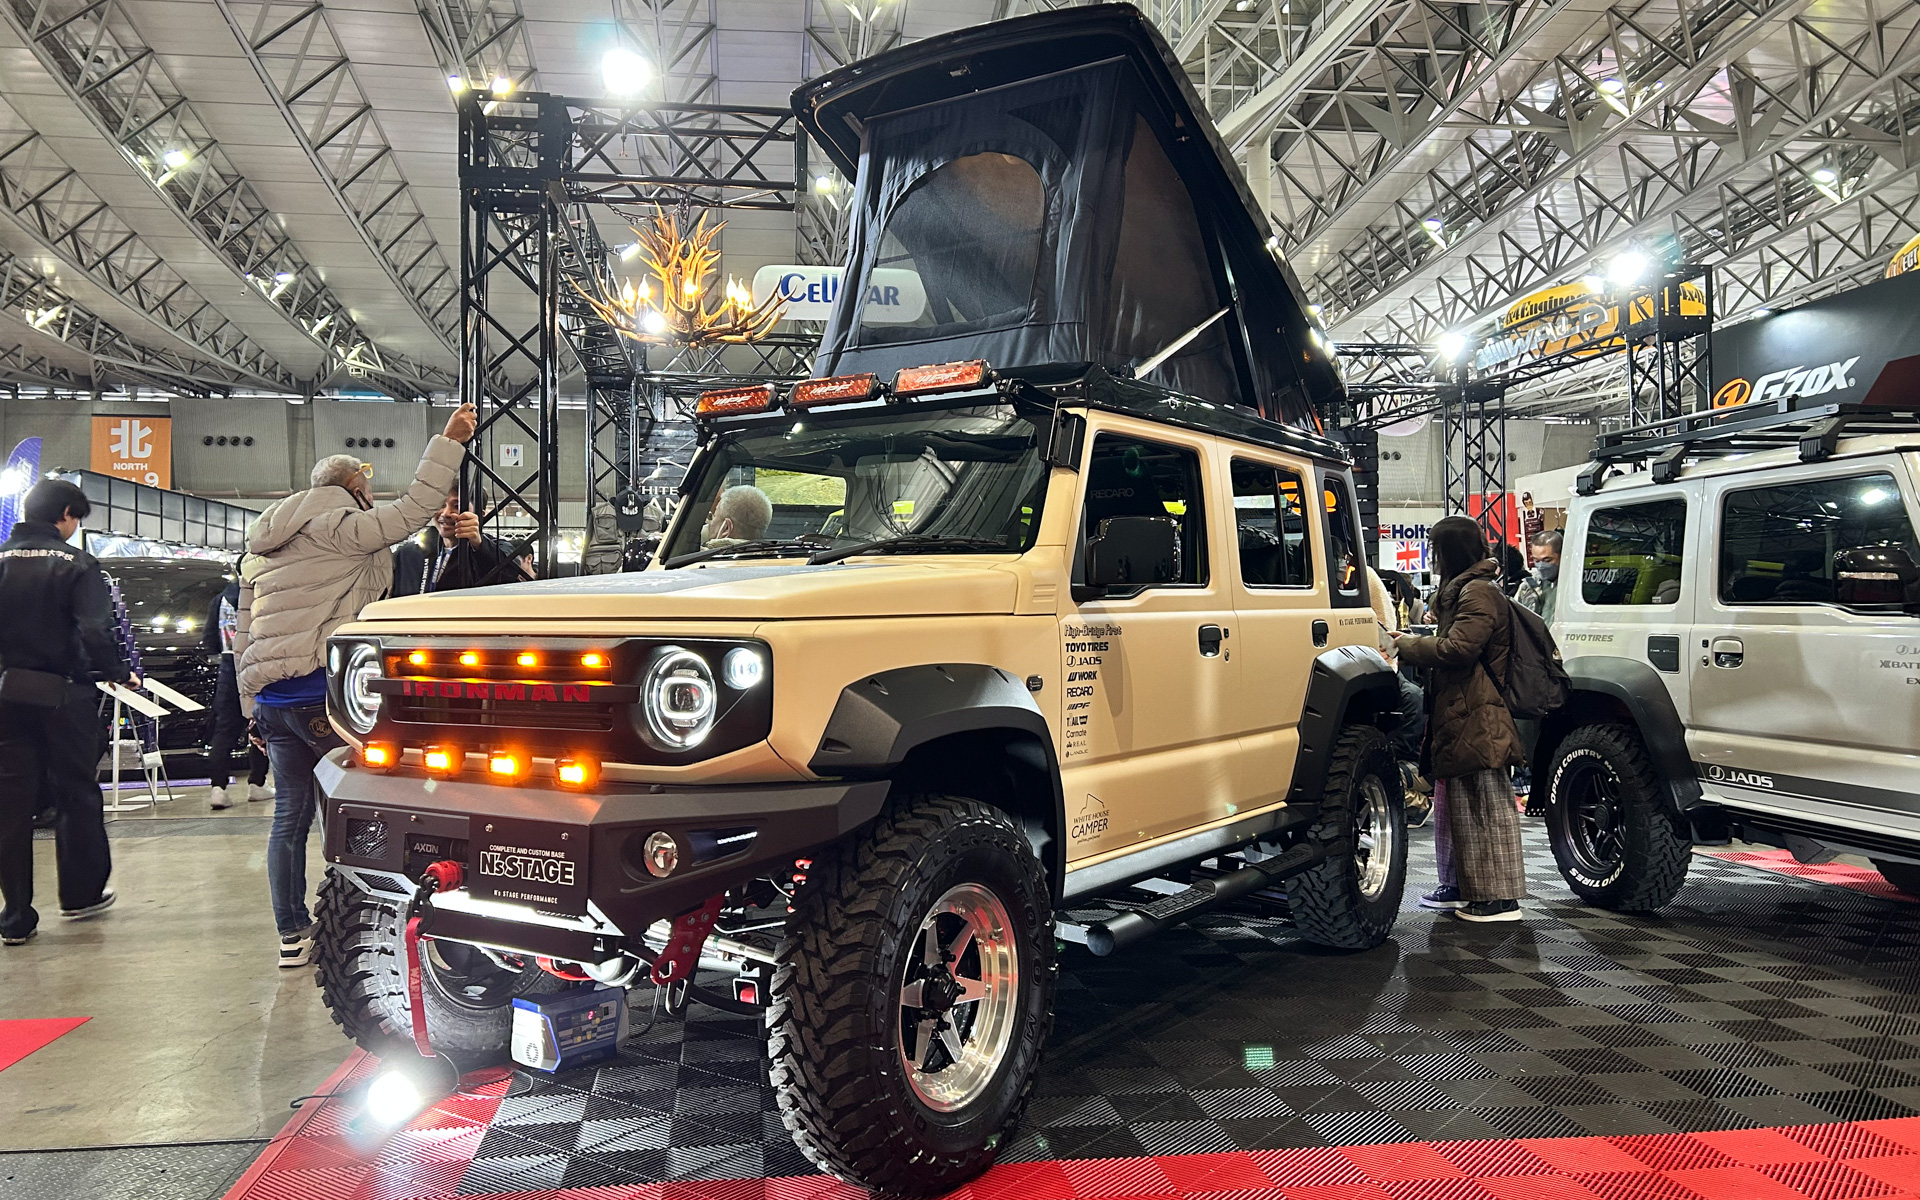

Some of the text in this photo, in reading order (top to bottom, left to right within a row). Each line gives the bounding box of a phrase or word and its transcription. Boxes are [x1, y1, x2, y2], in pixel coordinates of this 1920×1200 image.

[109, 419, 153, 459] 北
[639, 486, 679, 496] HITE
[1090, 487, 1135, 499] RECARO
[1565, 634, 1614, 642] TOYO TIRES
[1066, 641, 1109, 652] TOYO TIRES
[1076, 657, 1102, 666] JAOS
[1078, 671, 1098, 681] WORK
[403, 681, 591, 702] IRONMAN
[1066, 686, 1094, 698] RECARO
[1550, 766, 1563, 805] OPEN
[1562, 748, 1602, 768] COUNTRY
[1726, 771, 1774, 788] JAOS
[1073, 810, 1109, 824] WHITE HOUSE
[1071, 818, 1109, 839] CAMPER
[414, 842, 439, 854] AXON
[489, 844, 516, 854] COMPLETE
[528, 848, 551, 857] CUSTOM
[551, 851, 566, 859] BASE
[504, 855, 575, 886] STAGE
[1569, 861, 1625, 888] TOYO TIRES
[493, 889, 558, 904] N's STAGE PERFORMANCE
[410, 966, 421, 1000] WARN
